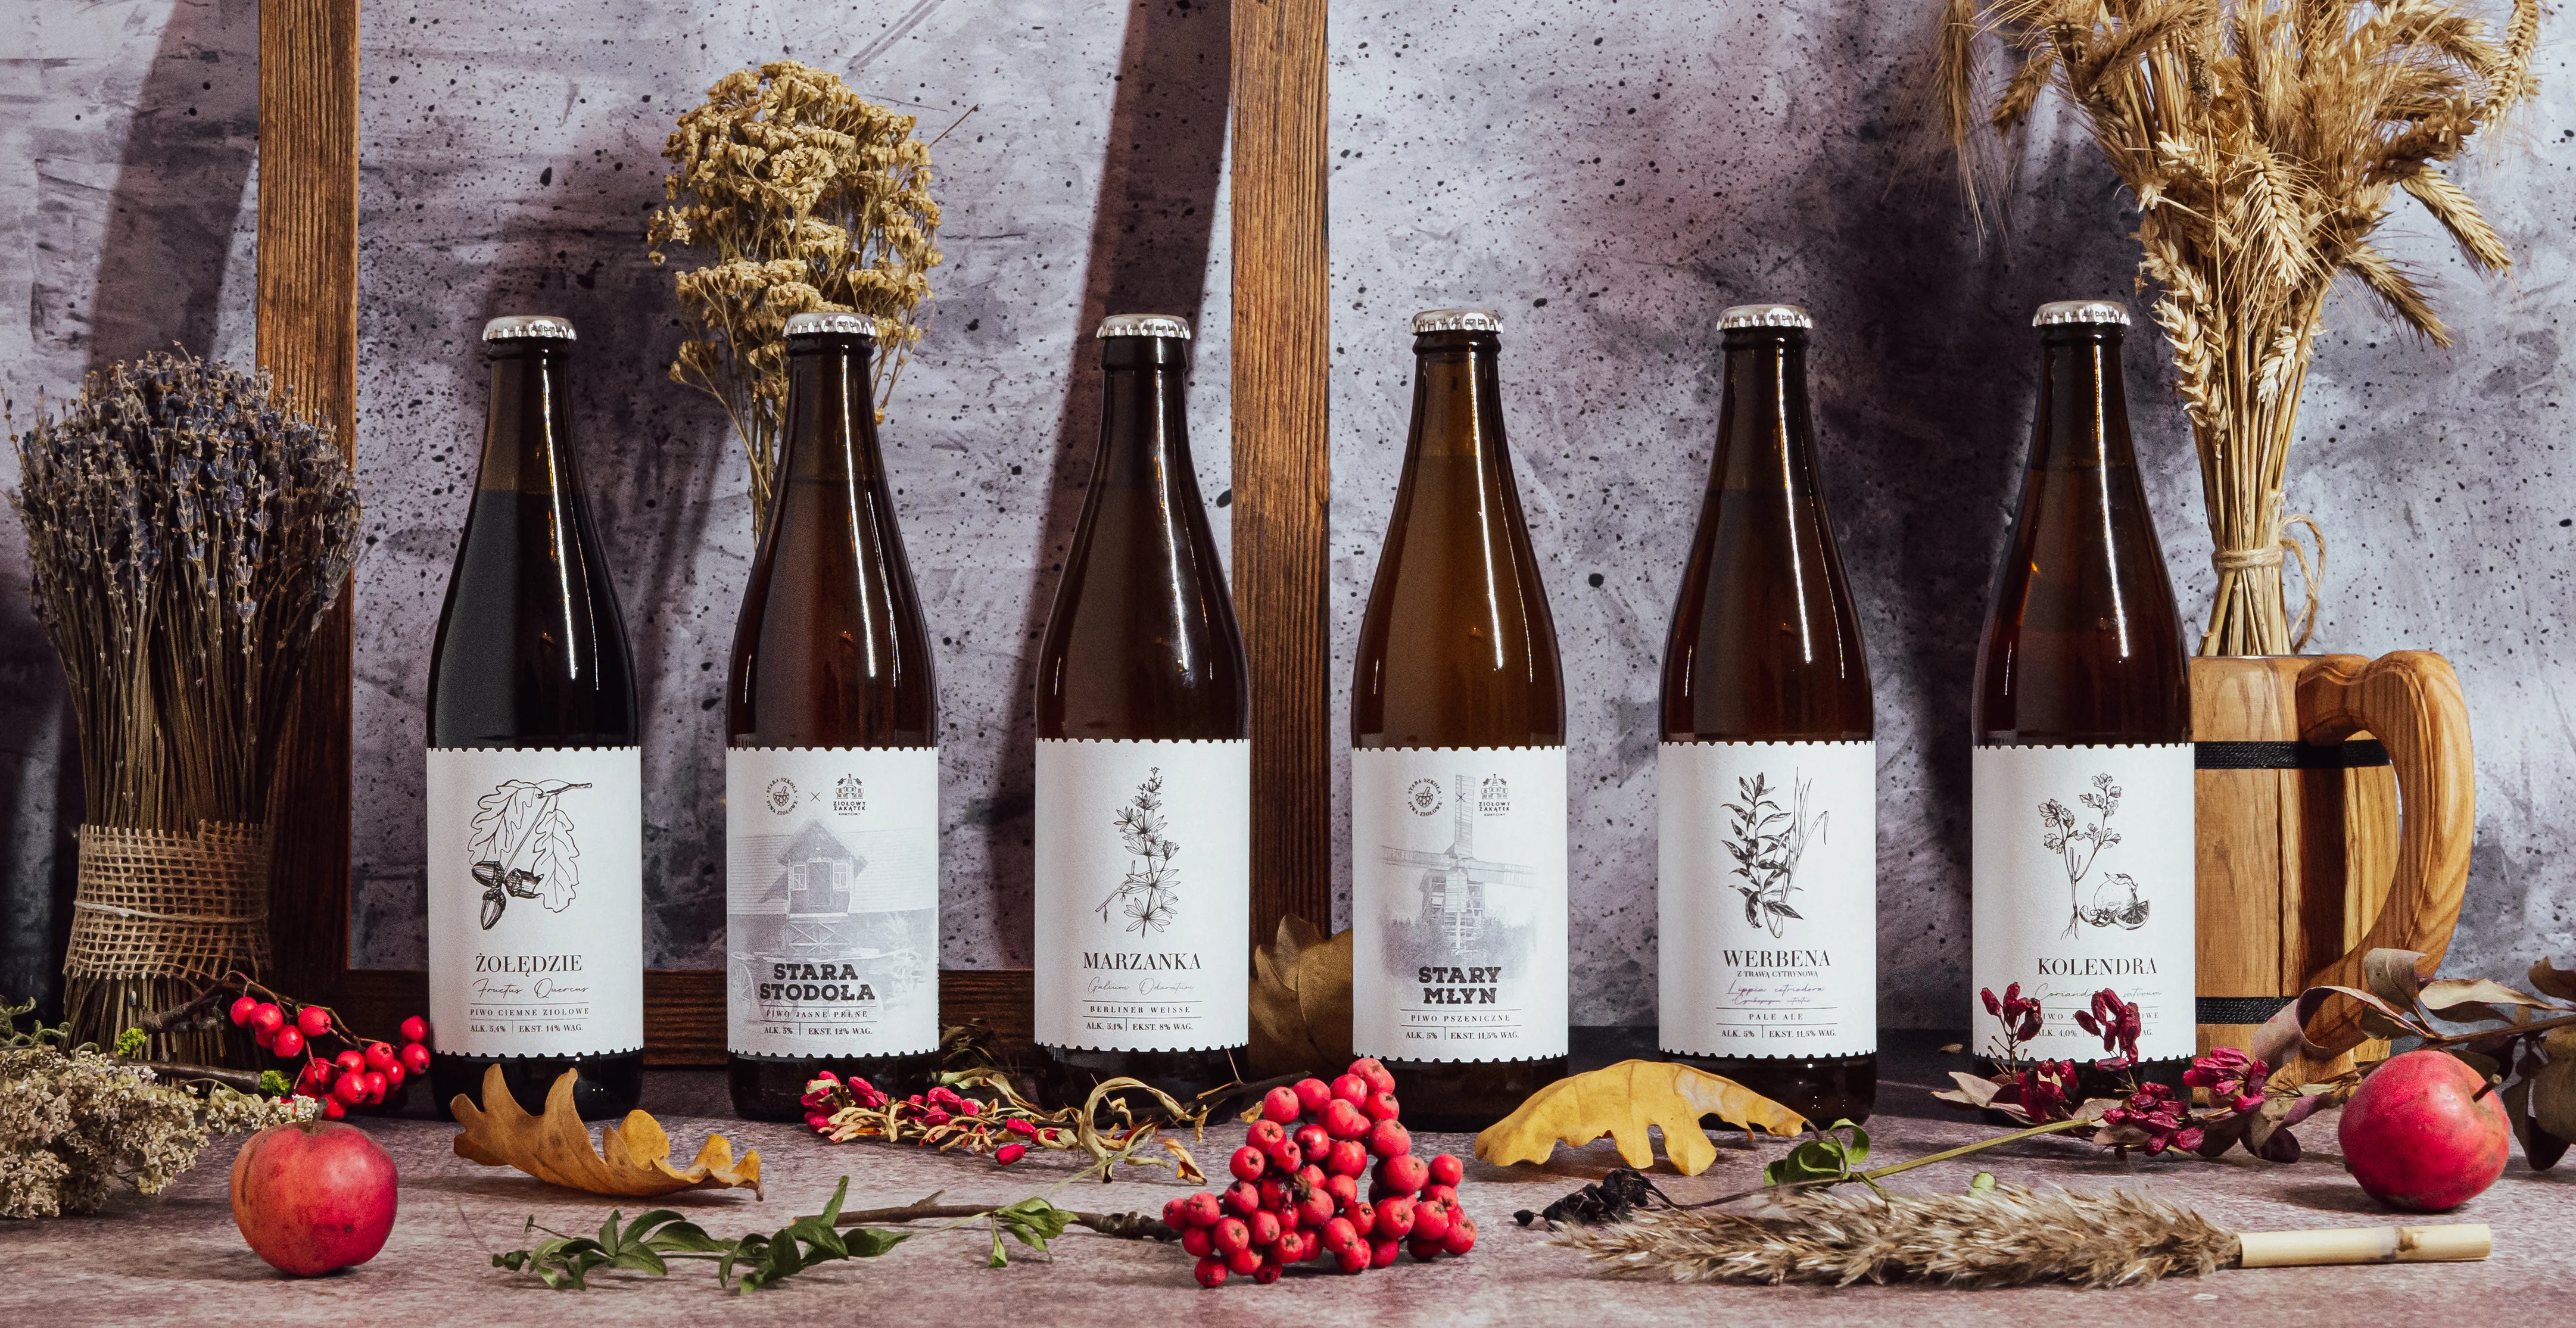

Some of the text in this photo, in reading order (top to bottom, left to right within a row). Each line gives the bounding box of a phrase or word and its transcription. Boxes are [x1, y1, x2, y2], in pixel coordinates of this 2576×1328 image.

[475, 953, 583, 977] ŻOŁĘDZIE
[1082, 952, 1202, 970] MARZANKA
[1722, 949, 1831, 967] WERBENA
[2036, 957, 2158, 975] KOLENDRA
[774, 962, 859, 980] STARA
[1418, 966, 1502, 984] STARY
[759, 983, 876, 1001] STODOŁA
[1423, 987, 1497, 1005] MŁYN
[766, 1010, 790, 1018] PIWO
[1090, 1005, 1144, 1014] BERLINER
[470, 1024, 488, 1033] ALK.
[852, 1027, 873, 1035] WAG.
[1086, 1022, 1104, 1030] ALK.
